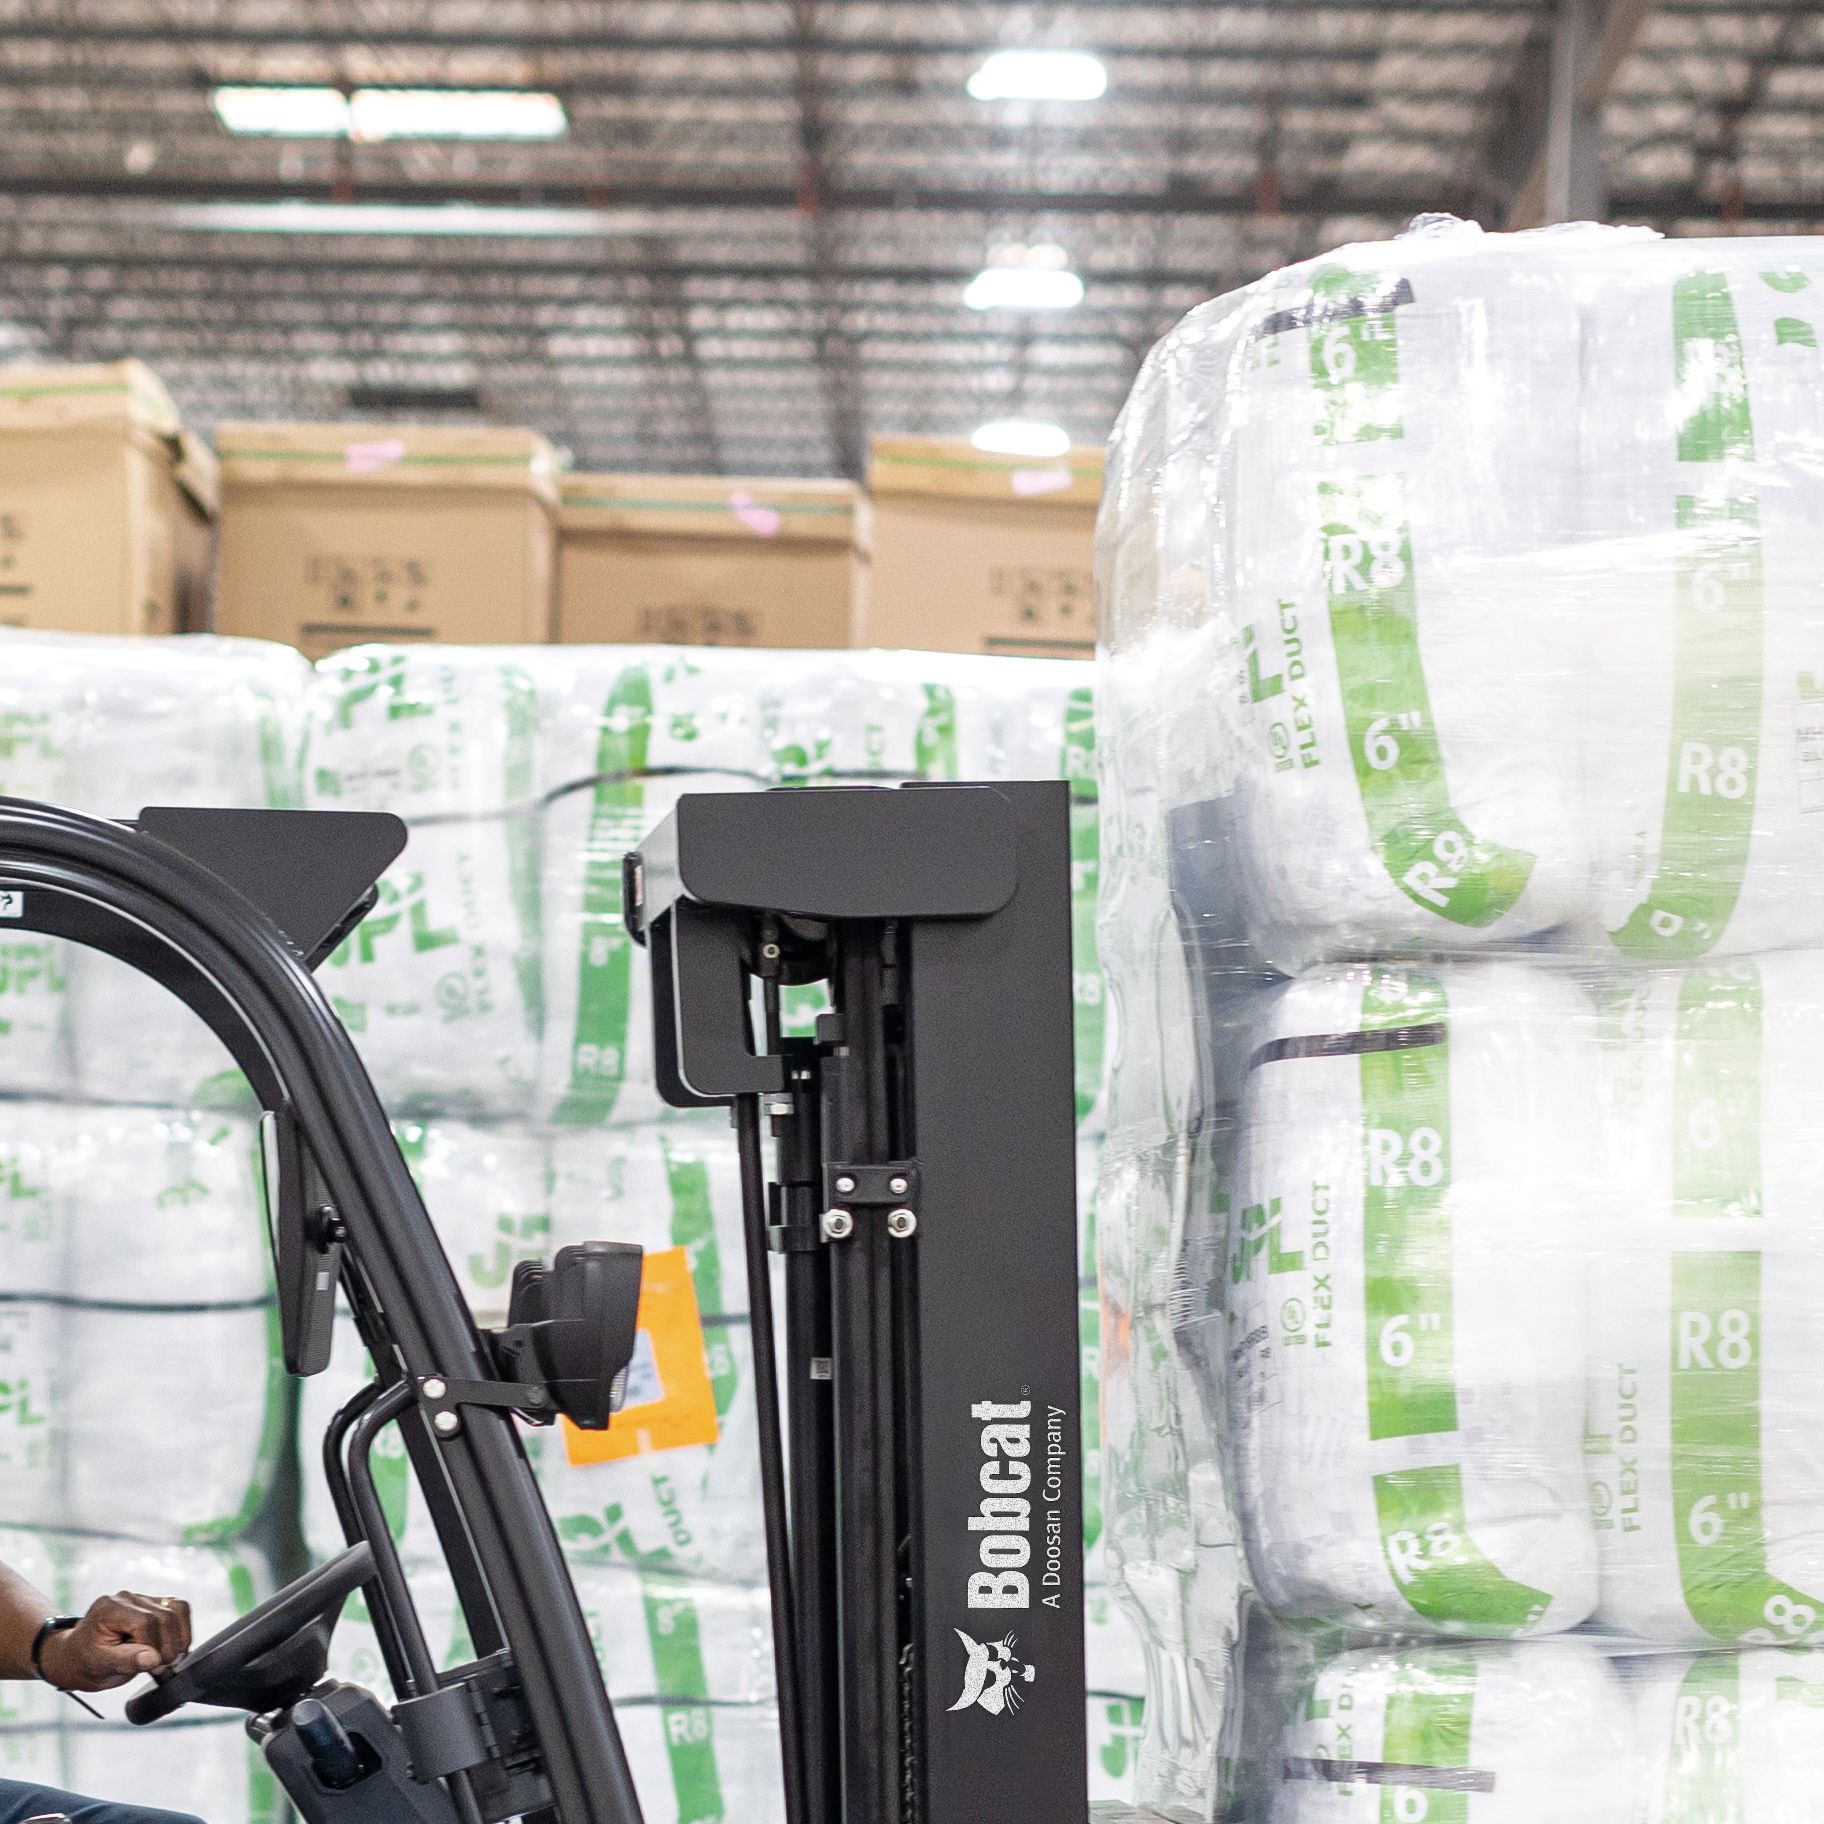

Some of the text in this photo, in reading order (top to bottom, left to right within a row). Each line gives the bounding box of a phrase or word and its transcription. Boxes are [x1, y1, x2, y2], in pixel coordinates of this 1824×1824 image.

[1691, 562, 1753, 613] 6"
[1278, 598, 1321, 771] FLEX DUCT
[1365, 711, 1423, 771] 6"
[1677, 742, 1751, 801] R8
[1369, 1126, 1446, 1187] R8
[1311, 1180, 1333, 1351] FLEX DUCT
[1378, 1312, 1442, 1369] 6"
[1677, 1310, 1754, 1372] R8
[1619, 1361, 1643, 1534] FLEX DUCT
[968, 1401, 1031, 1609] Bobcat
[1042, 1405, 1066, 1609] A Doosan Company
[1687, 1491, 1751, 1547] 6"
[1387, 1519, 1463, 1586] R8
